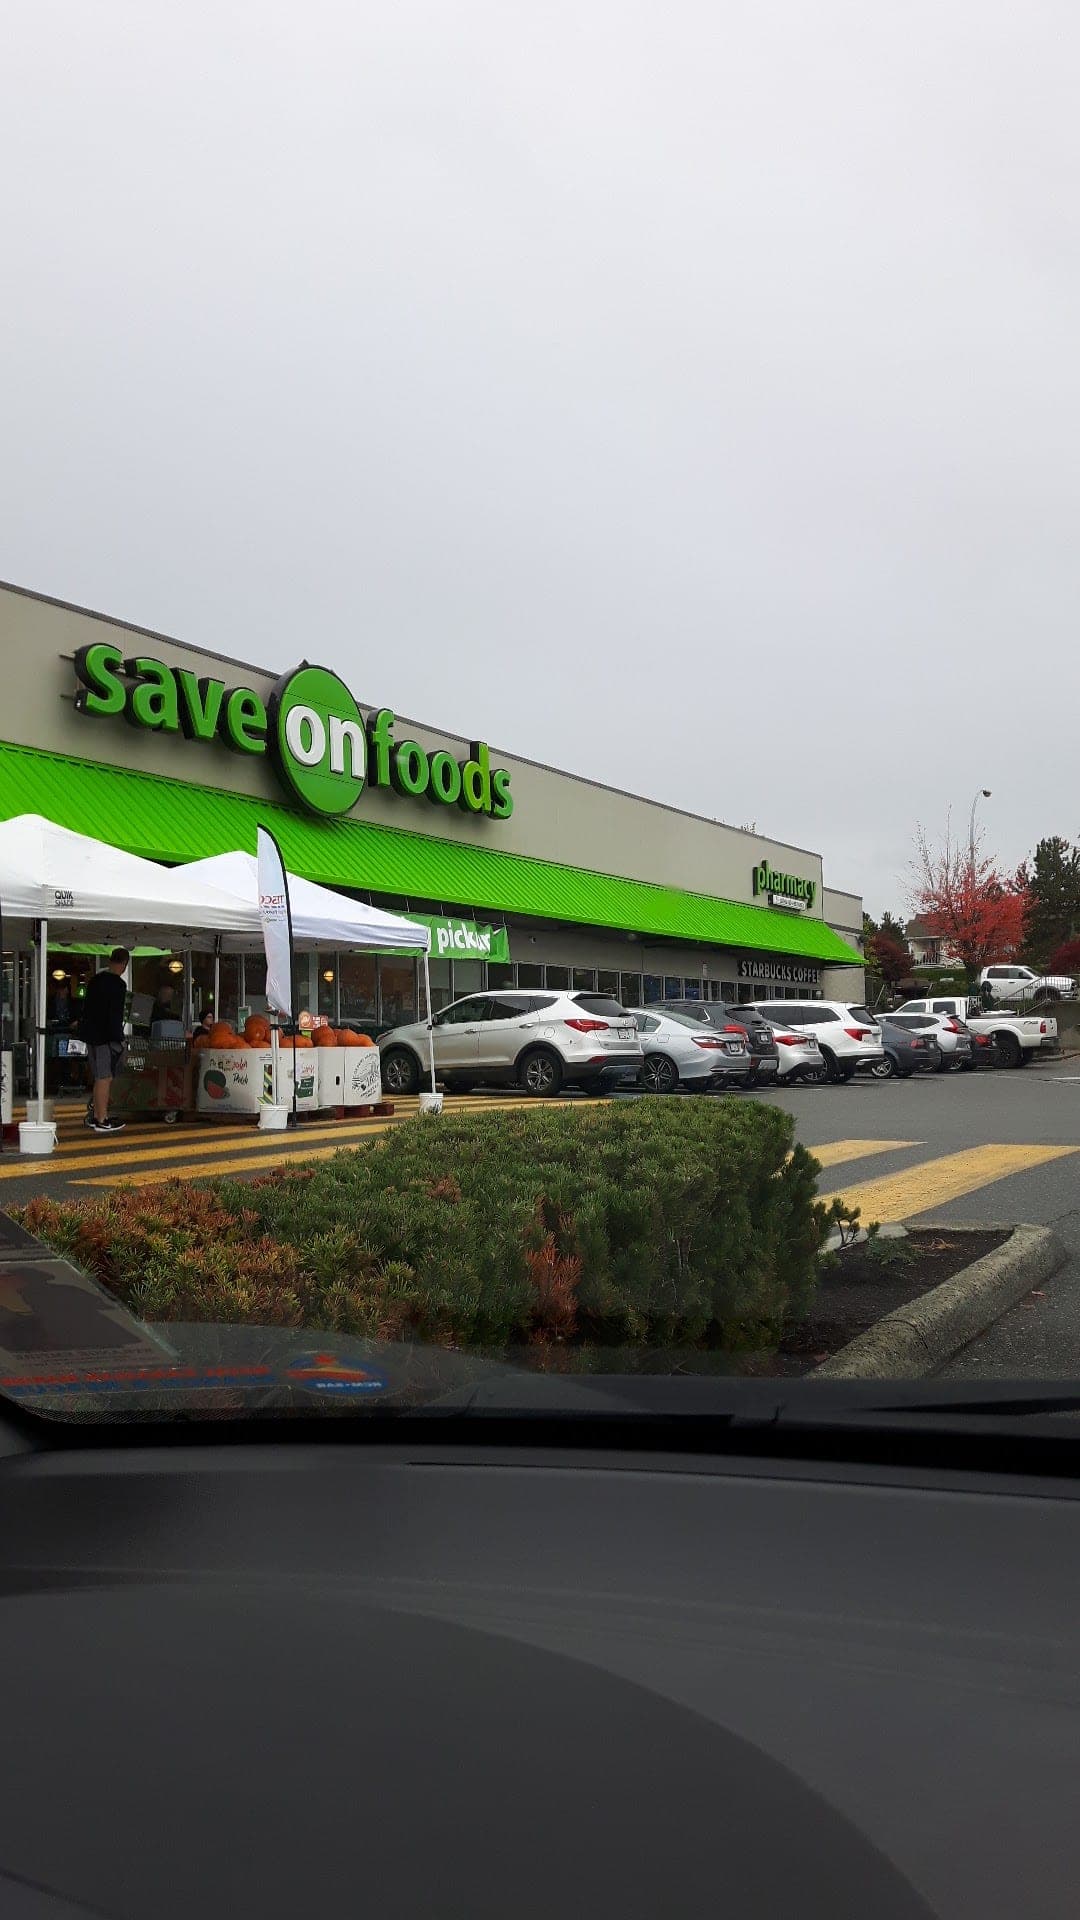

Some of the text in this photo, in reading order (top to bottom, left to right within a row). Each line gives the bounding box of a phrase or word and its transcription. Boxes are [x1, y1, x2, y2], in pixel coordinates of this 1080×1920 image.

[75, 642, 514, 819] save on foods
[54, 890, 74, 899] QUIK
[754, 860, 817, 909] pharmacy
[741, 960, 820, 983] STARBUCKS COFFEE
